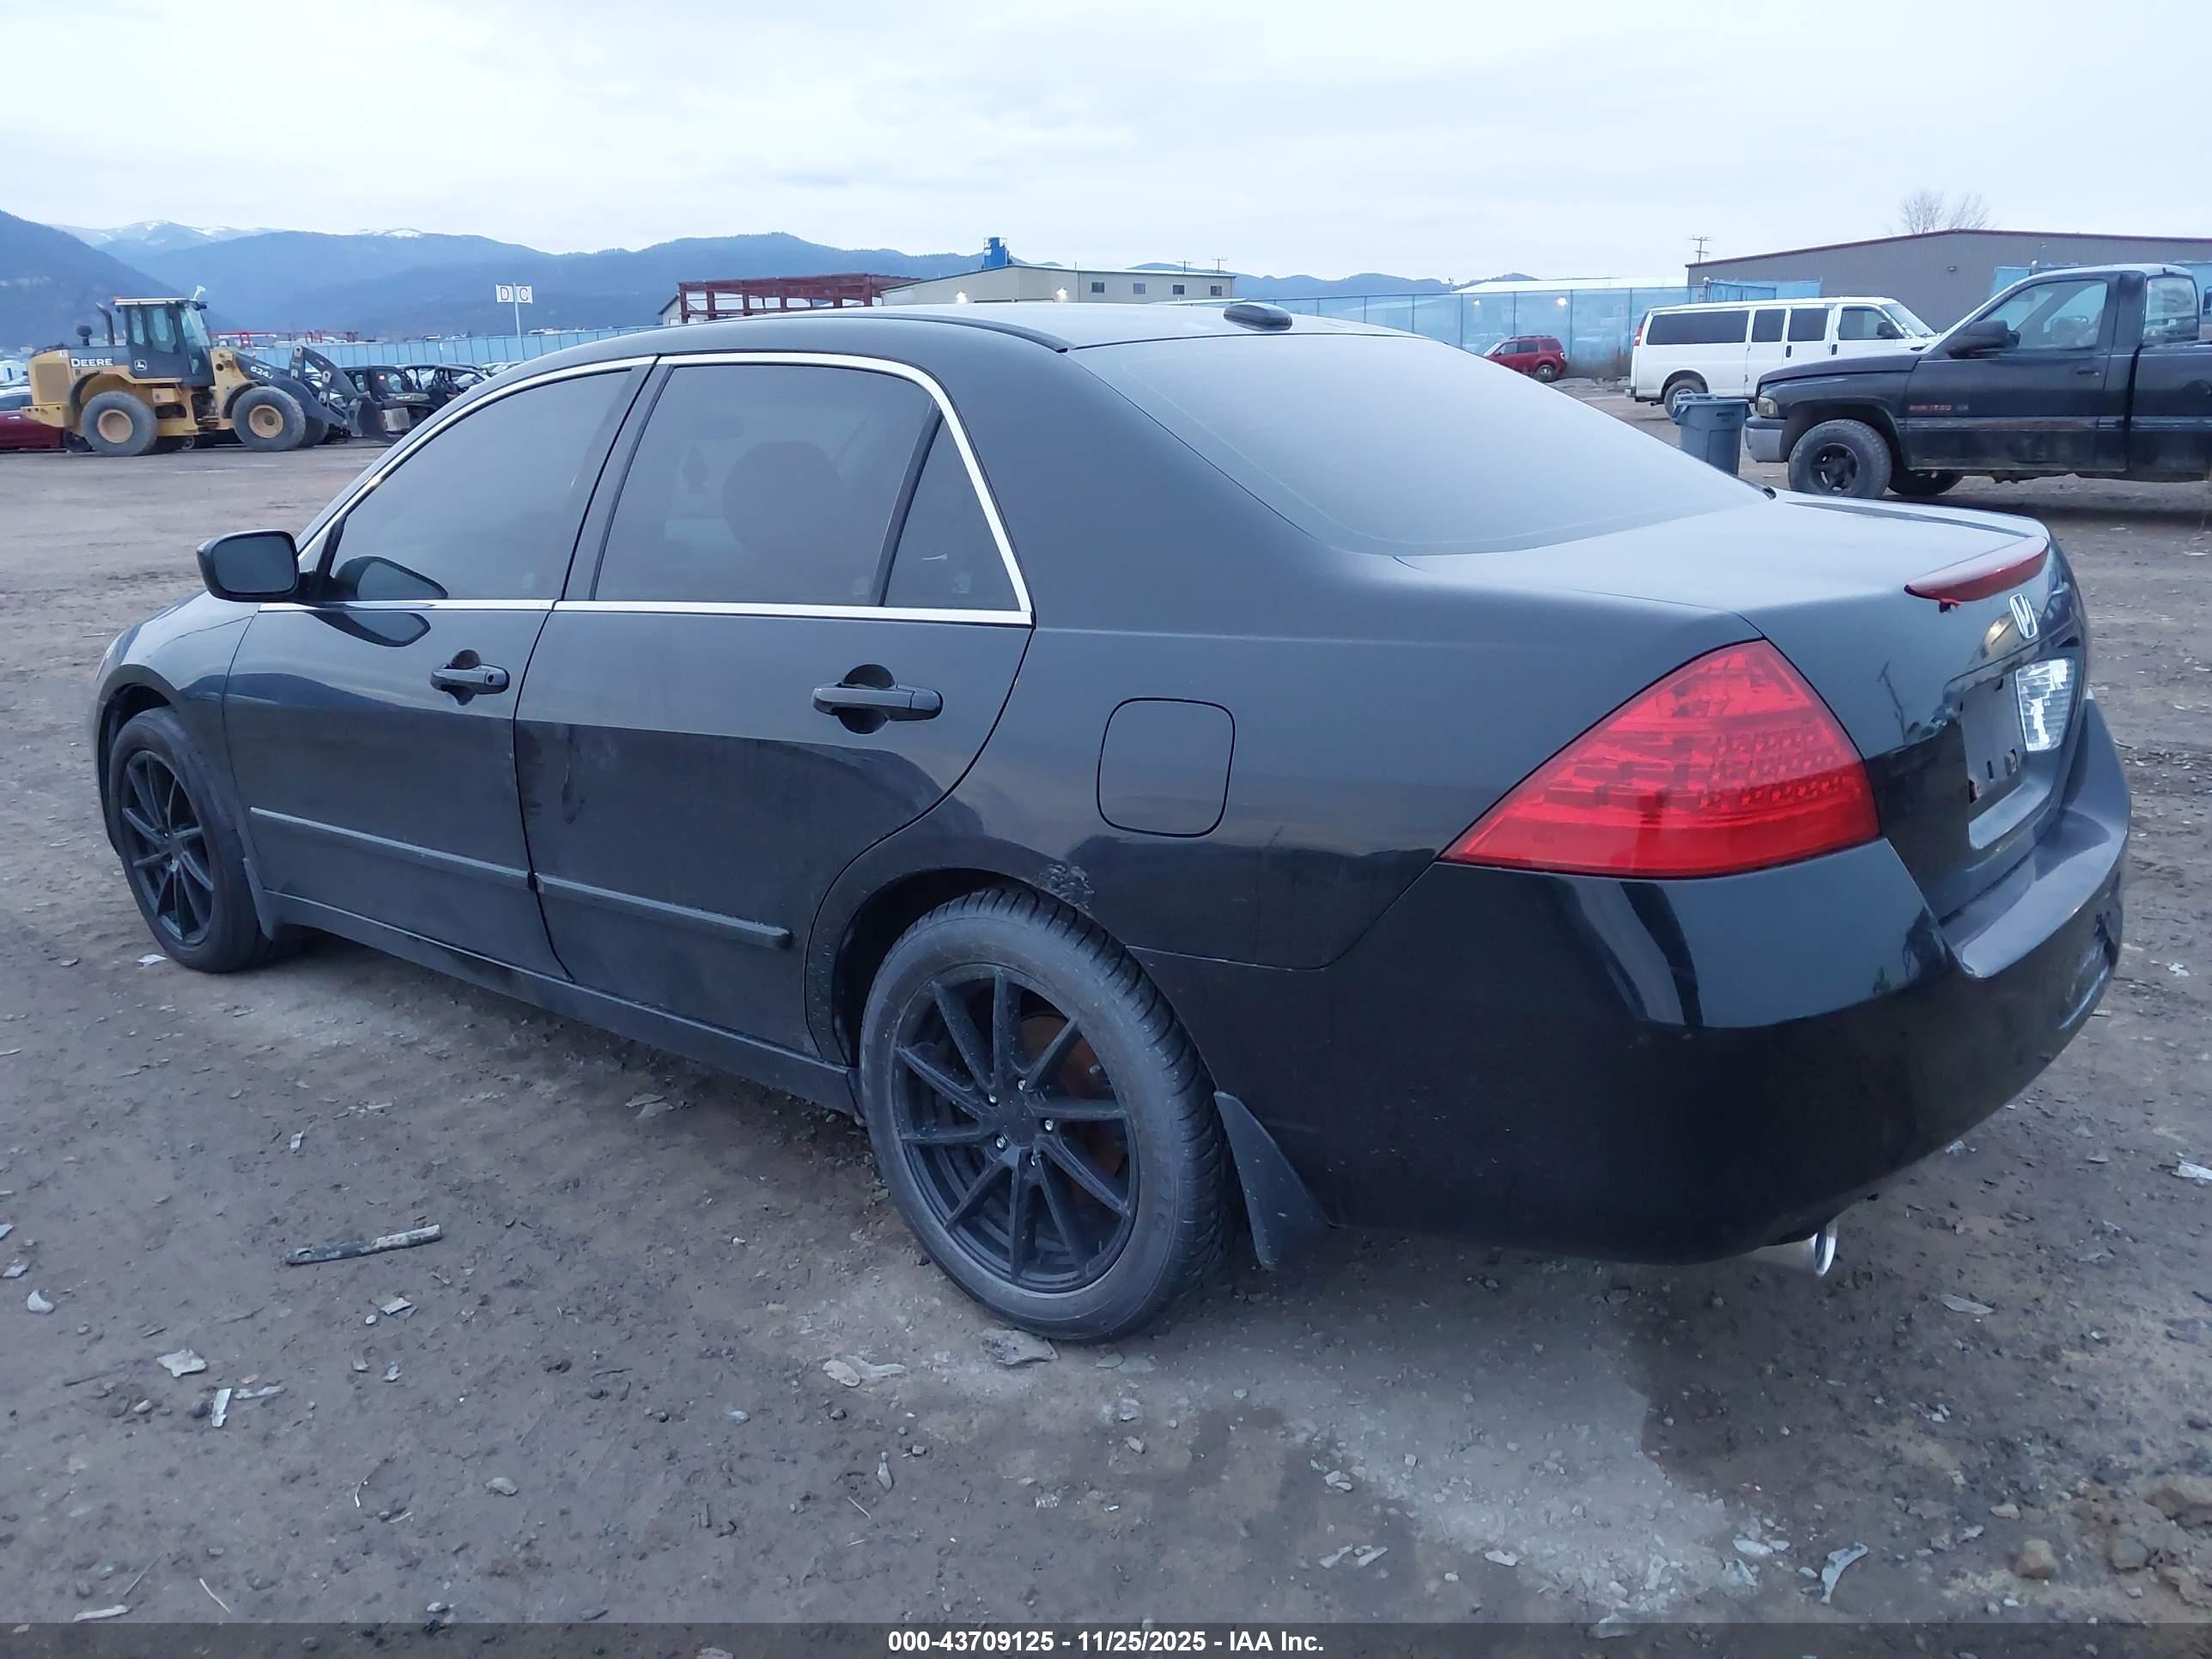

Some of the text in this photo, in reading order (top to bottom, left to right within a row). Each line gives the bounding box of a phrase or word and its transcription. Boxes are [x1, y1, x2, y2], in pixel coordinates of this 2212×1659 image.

[500, 286, 510, 301] D
[519, 287, 529, 301] C
[70, 357, 113, 368] DEERE
